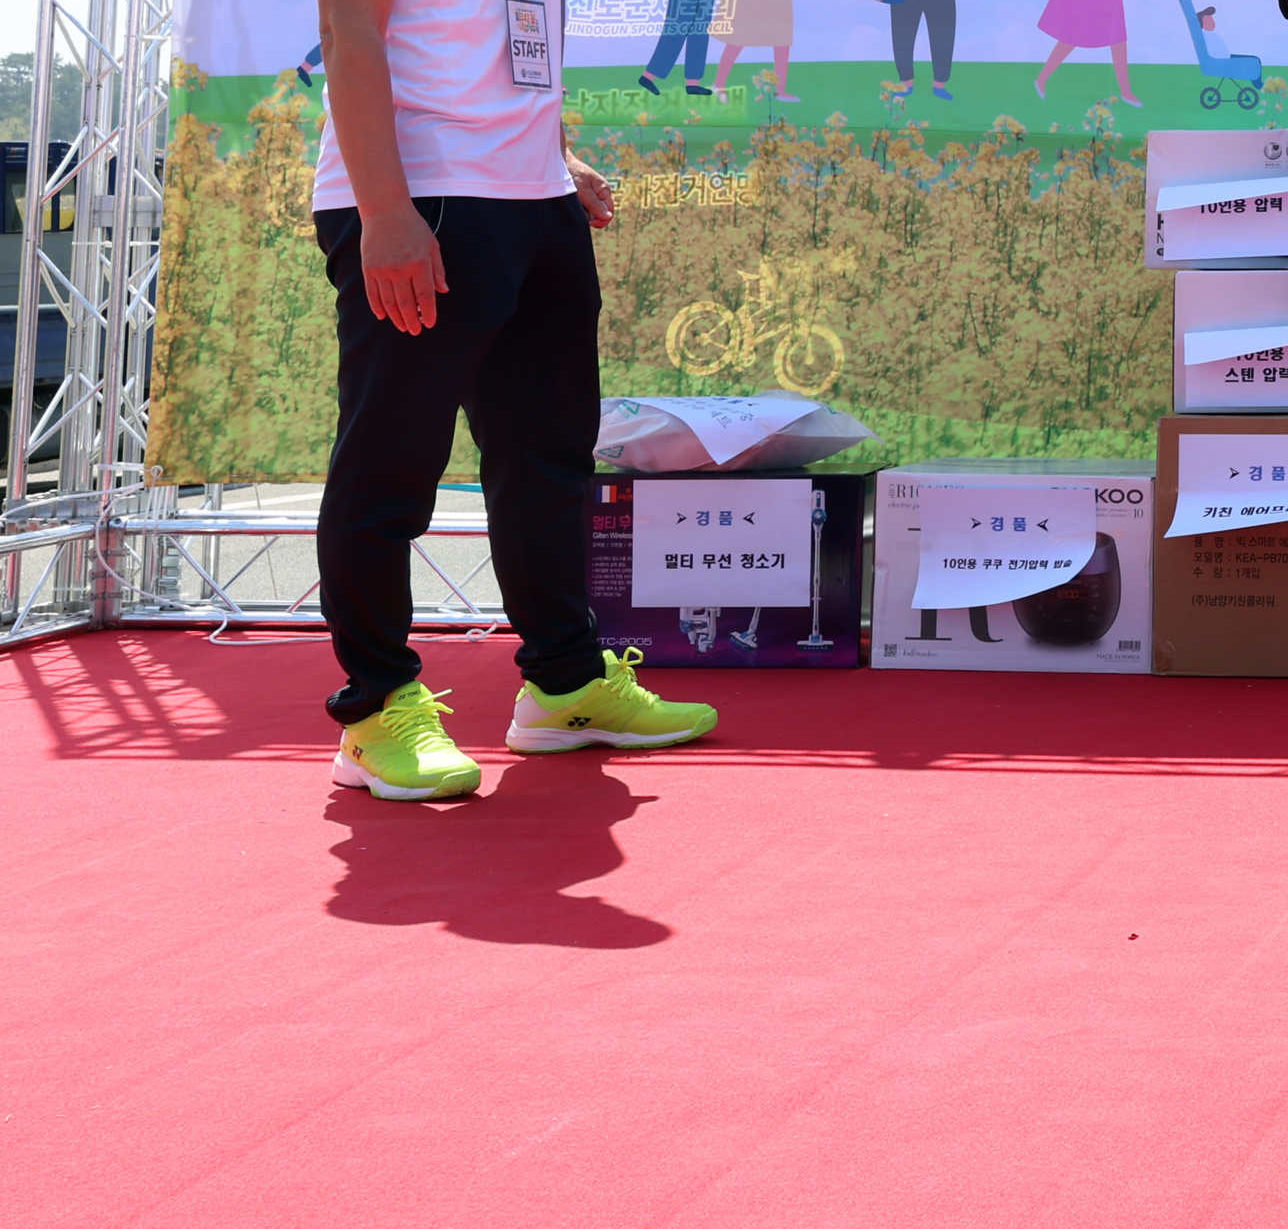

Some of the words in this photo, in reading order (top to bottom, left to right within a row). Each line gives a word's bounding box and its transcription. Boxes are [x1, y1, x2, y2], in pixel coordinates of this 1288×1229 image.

[565, 23, 628, 35] JINDOGUN
[631, 23, 676, 35] SPORTS
[681, 22, 732, 34] COUNCIL
[513, 40, 546, 59] STAFF
[1255, 197, 1283, 213] 압력
[1225, 367, 1255, 383] 스텐
[1249, 466, 1262, 481] 경
[1271, 466, 1286, 481] 품
[696, 511, 710, 526] 경
[719, 511, 733, 526] 품
[1202, 507, 1231, 518] 키친
[990, 517, 1004, 532] 경
[1013, 517, 1027, 532] 품
[1248, 537, 1275, 547] 스마트
[665, 554, 694, 569] 멀티
[702, 554, 731, 569] 무선
[740, 553, 785, 569] 청소기
[943, 558, 977, 570] 10인용
[983, 558, 1003, 570] 쿠쿠
[1008, 559, 1048, 570] 전기압력
[1193, 552, 1223, 563] 모델명
[1193, 567, 1202, 577] 수
[1236, 568, 1260, 579] 1개입
[599, 637, 652, 646] TC-2005
